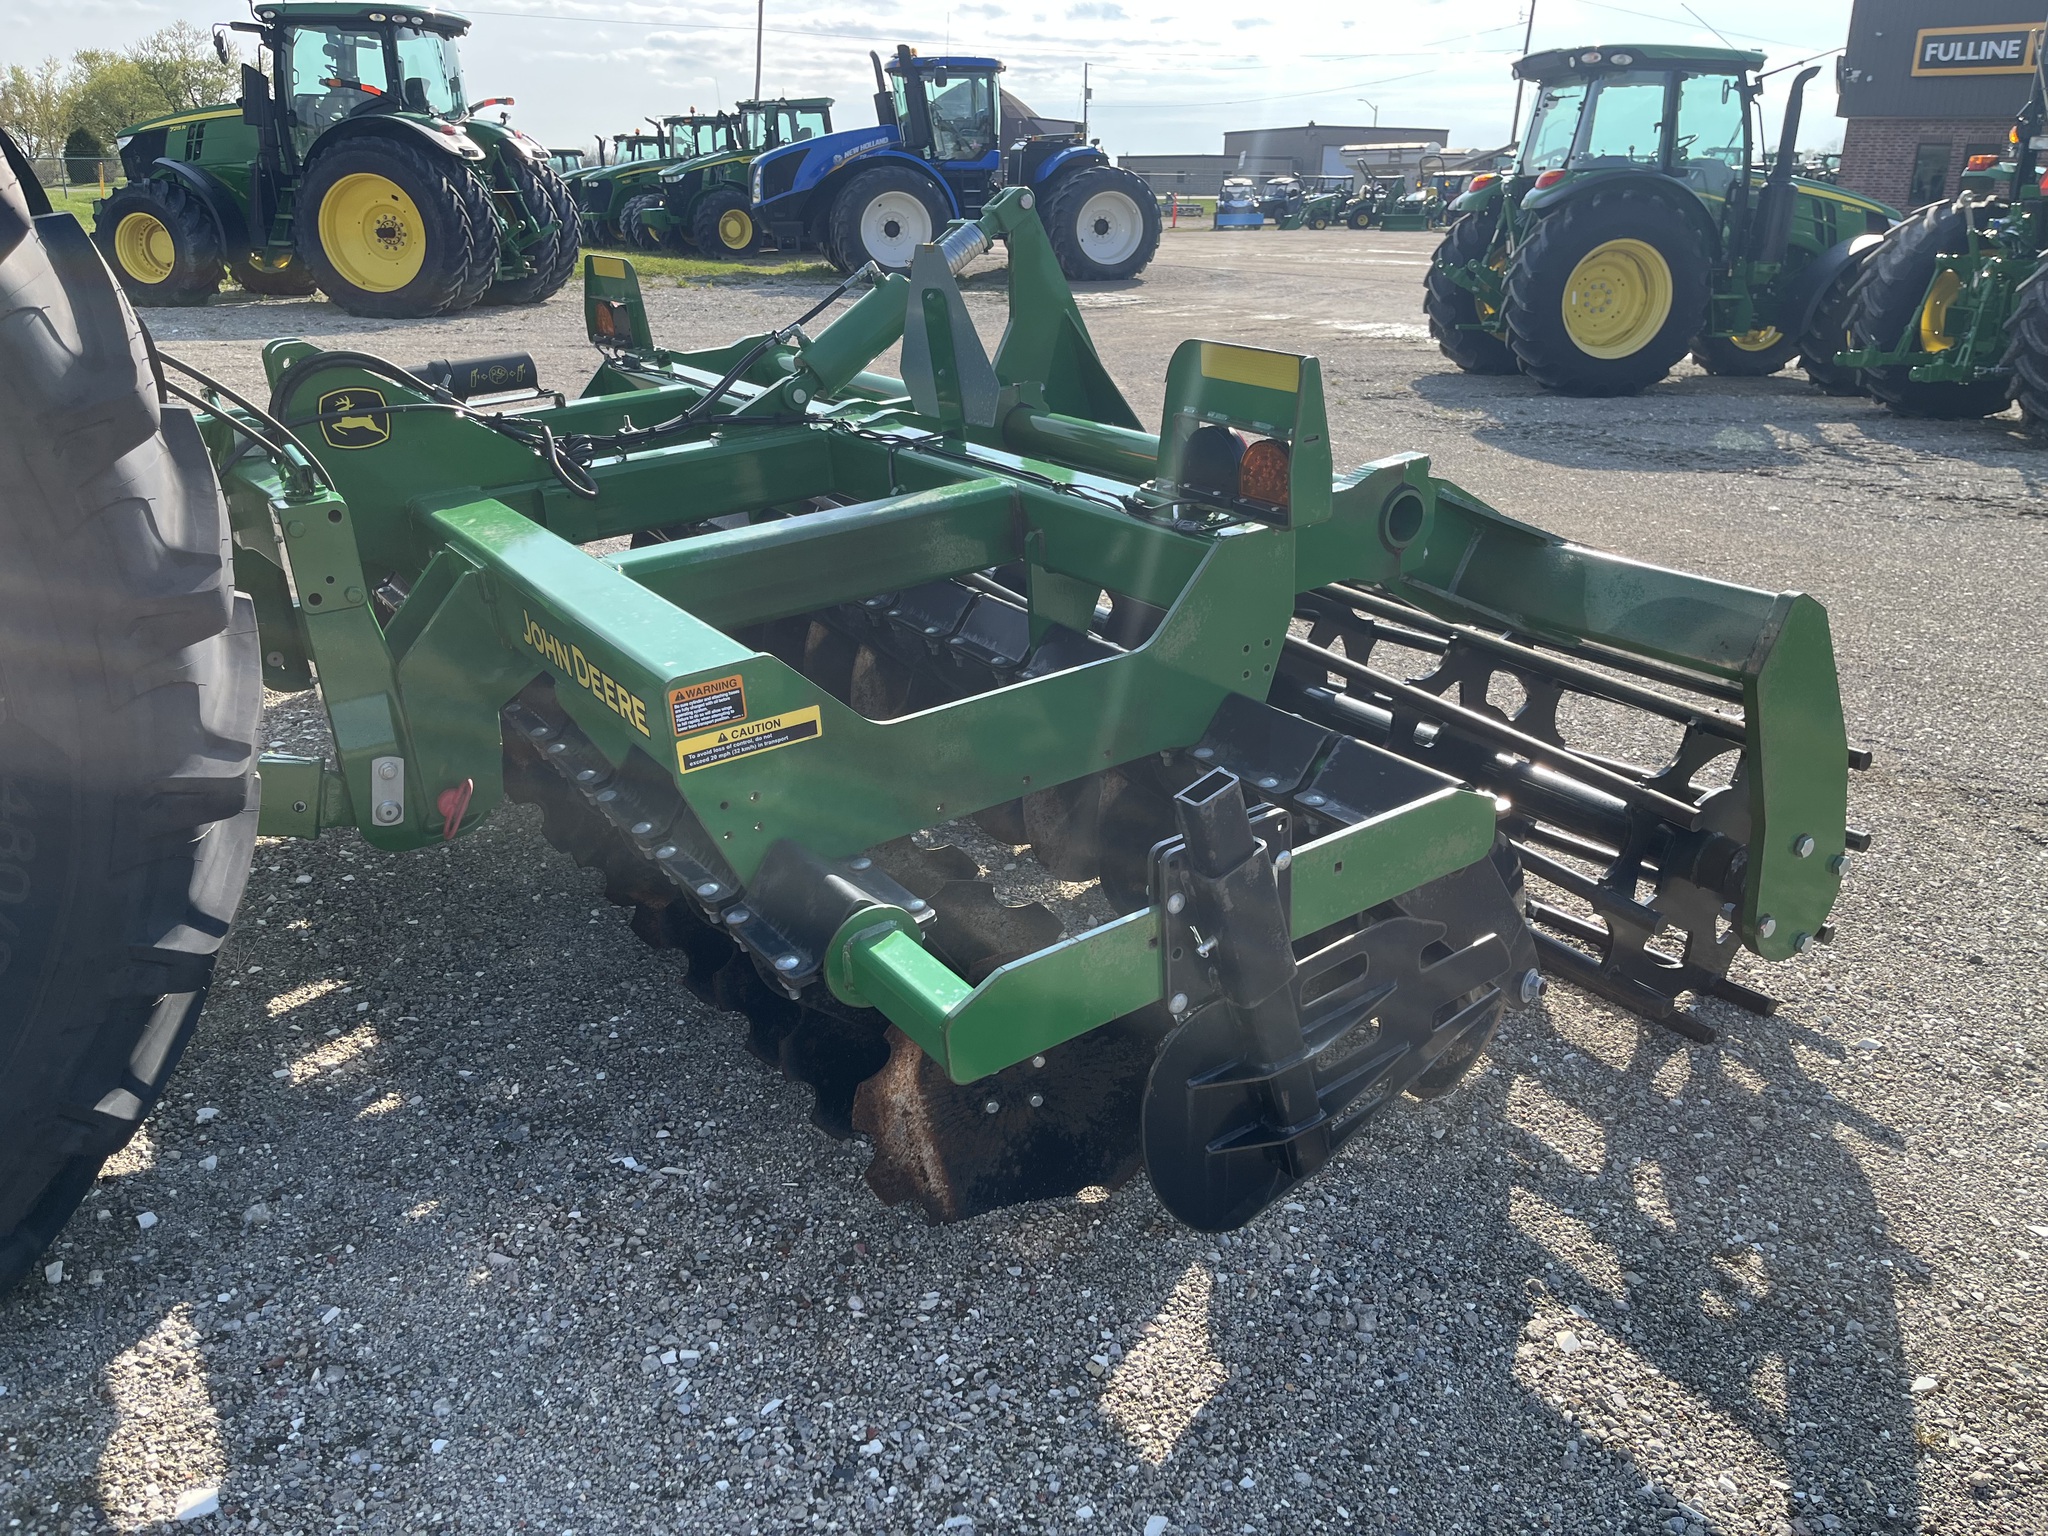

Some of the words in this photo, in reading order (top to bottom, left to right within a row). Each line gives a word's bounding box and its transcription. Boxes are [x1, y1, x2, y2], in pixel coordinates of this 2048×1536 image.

[1924, 40, 2022, 62] FULLINE
[844, 146, 860, 159] NEW
[860, 136, 888, 151] HOLLAND
[523, 608, 573, 677] JOHN
[571, 643, 651, 738] DEERE
[686, 679, 737, 698] WARNING
[731, 719, 781, 739] CAUTION
[690, 757, 709, 766] exceed
[764, 736, 789, 746] transport
[733, 739, 754, 748] control,
